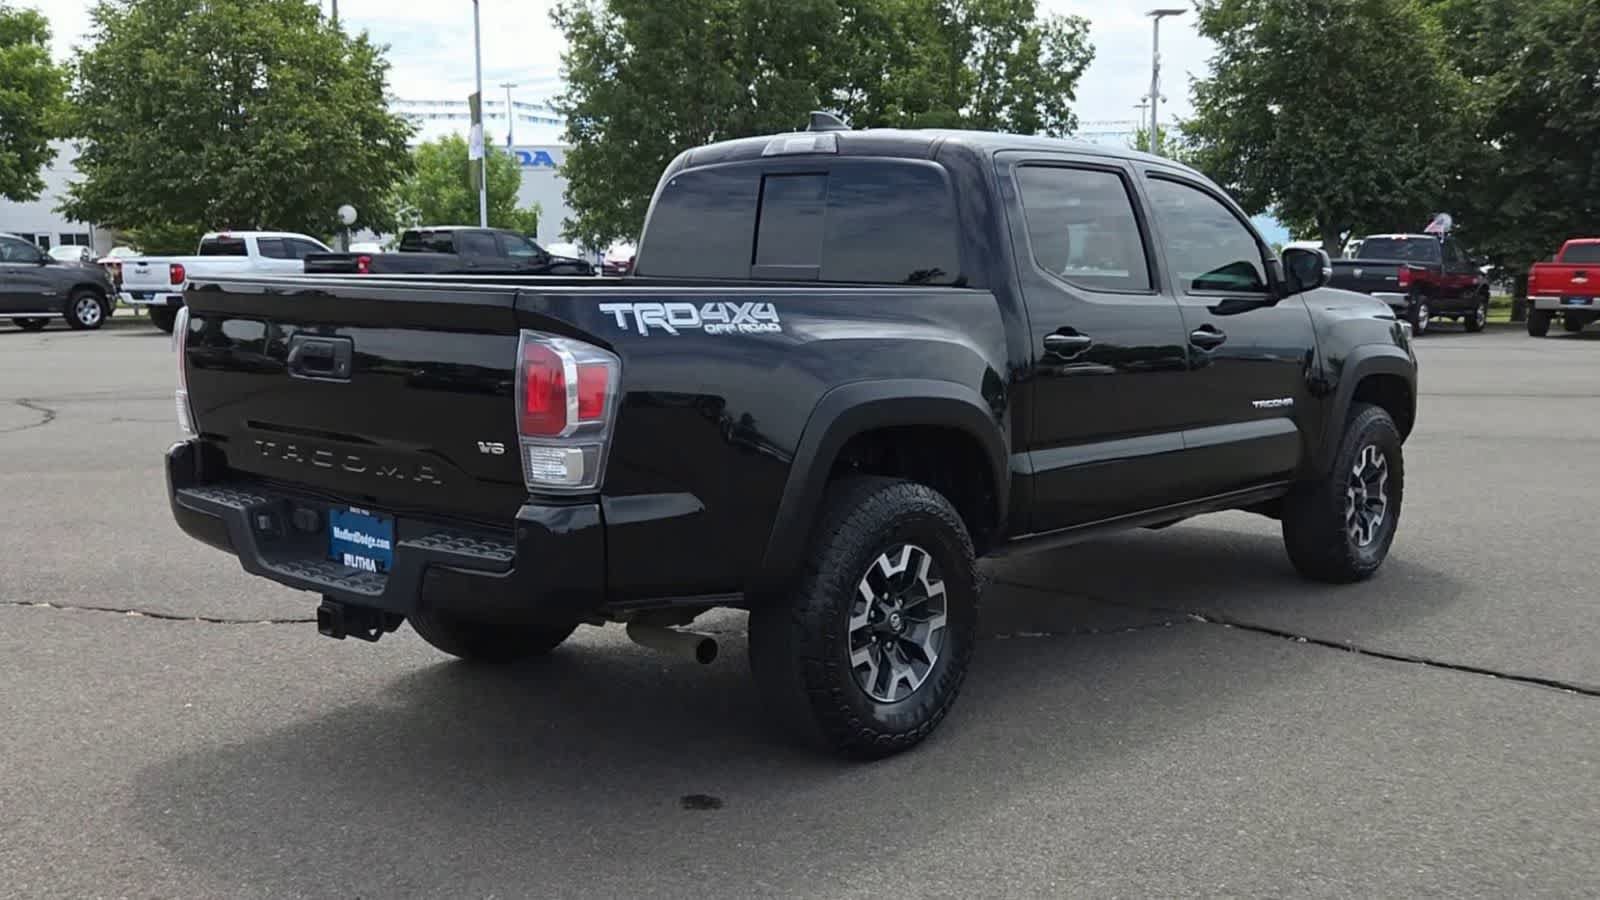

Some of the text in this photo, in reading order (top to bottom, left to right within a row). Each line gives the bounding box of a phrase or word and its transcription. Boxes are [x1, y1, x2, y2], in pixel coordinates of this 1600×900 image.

[599, 303, 702, 336] TRD
[704, 323, 782, 335] OFF ROAD
[1252, 397, 1294, 409] TACOMA
[477, 441, 505, 455] V6
[254, 439, 443, 485] TACOMA
